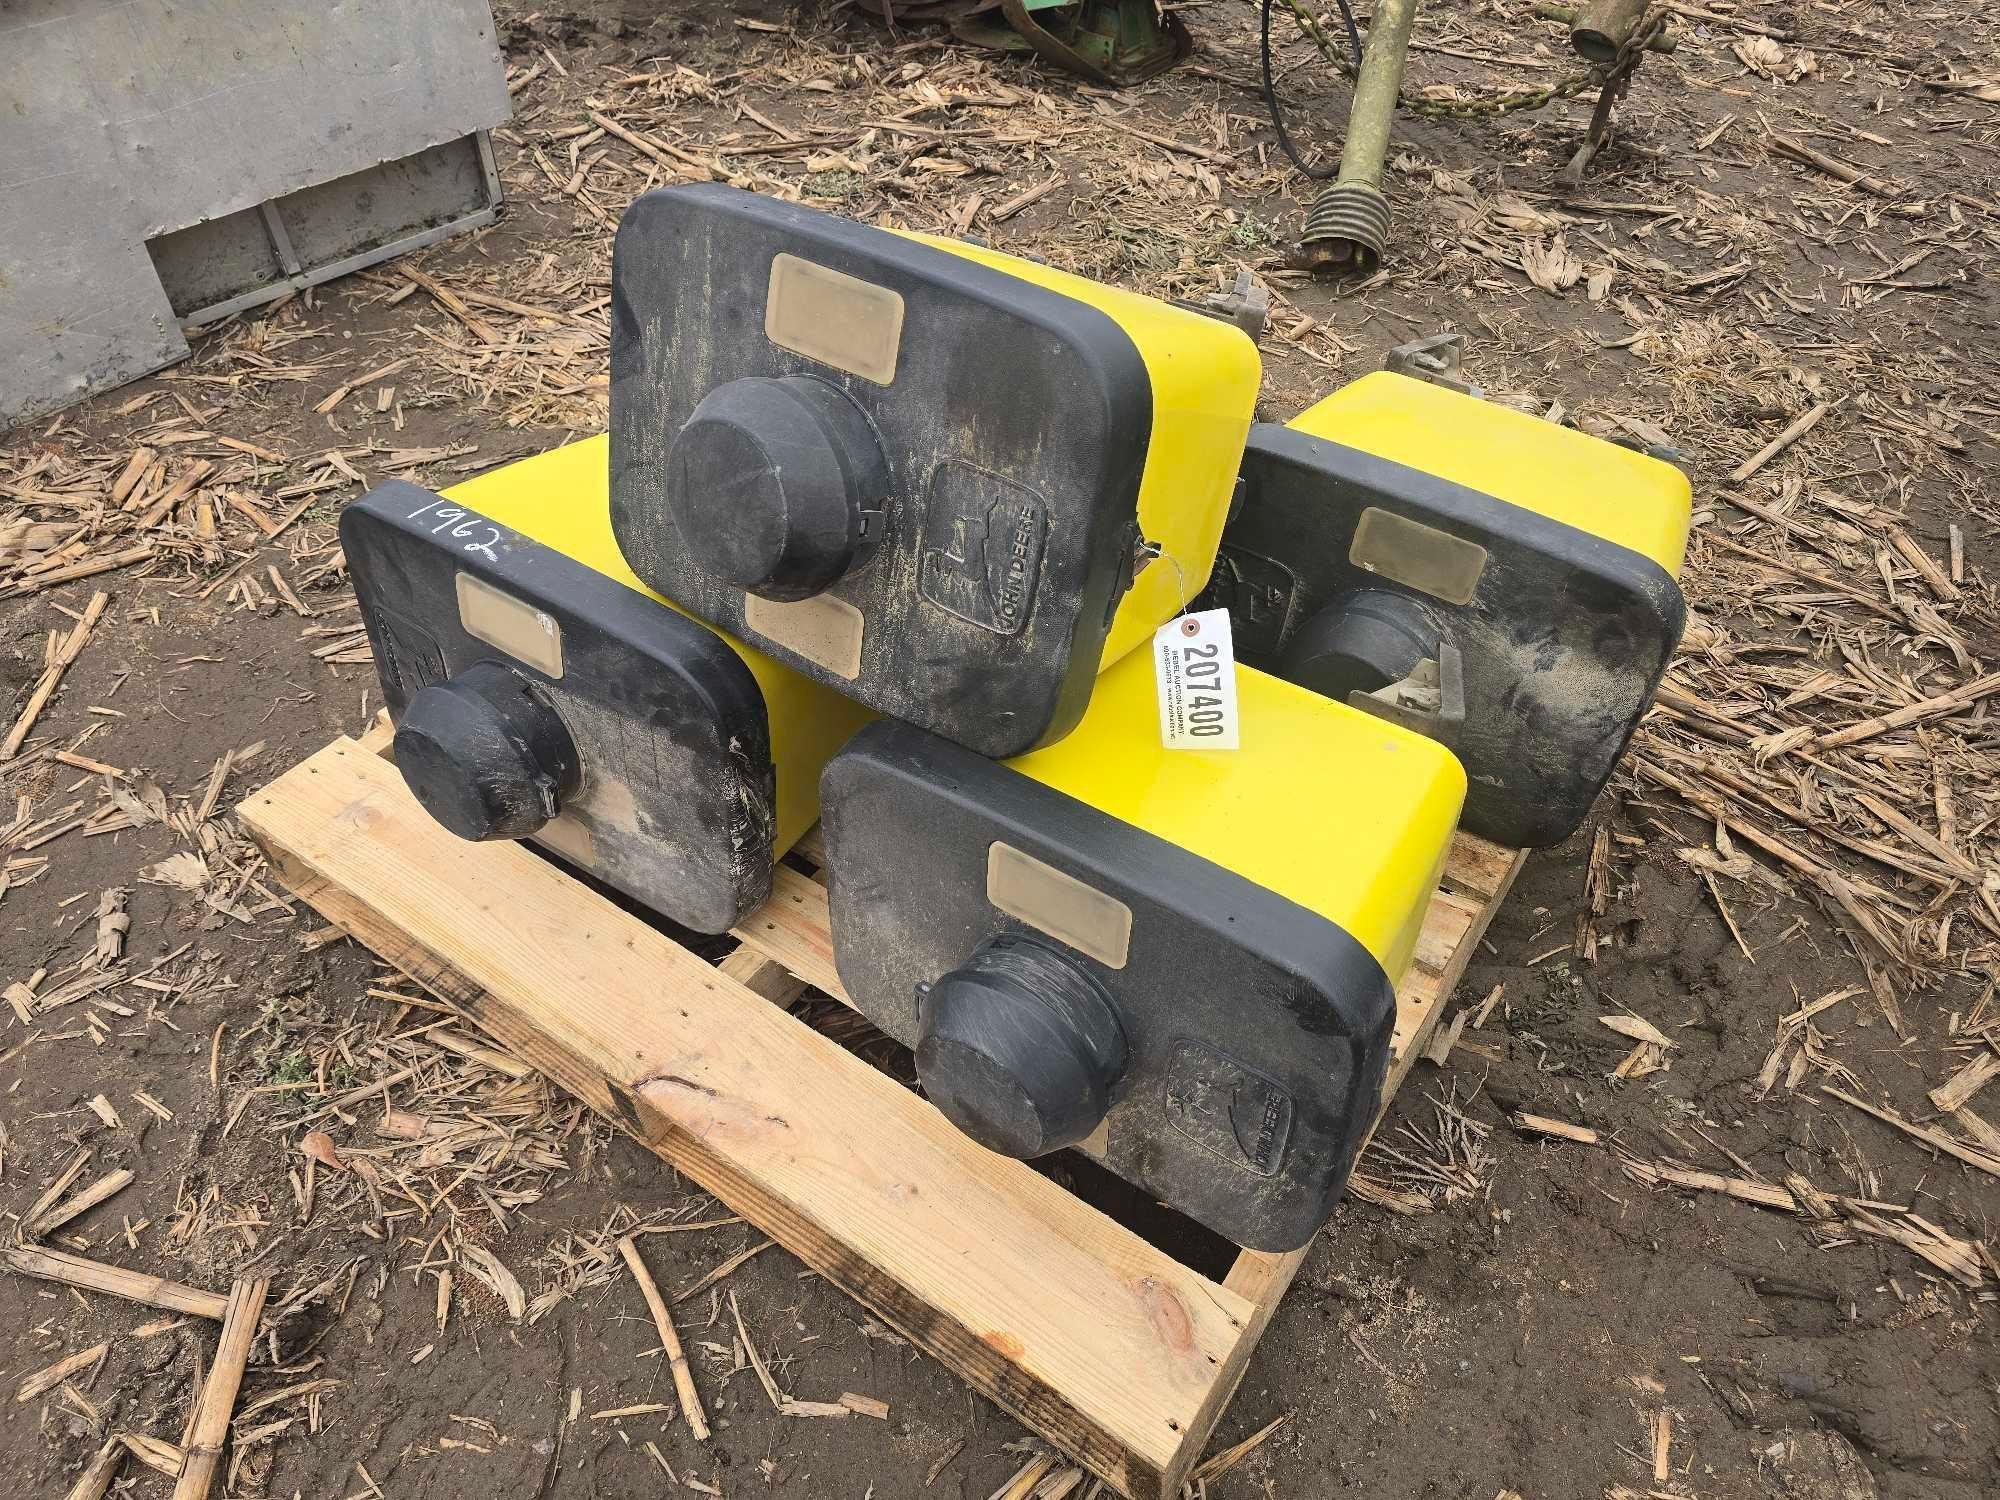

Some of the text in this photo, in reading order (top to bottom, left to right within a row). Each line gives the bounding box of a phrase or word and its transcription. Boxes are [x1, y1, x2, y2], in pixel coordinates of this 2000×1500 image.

[406, 499, 500, 562] 1962
[1000, 506, 1035, 628] JOHN DEERE
[1174, 675, 1184, 705] AUCTION
[1176, 706, 1185, 735] COMPANY
[1183, 643, 1224, 737] 207400
